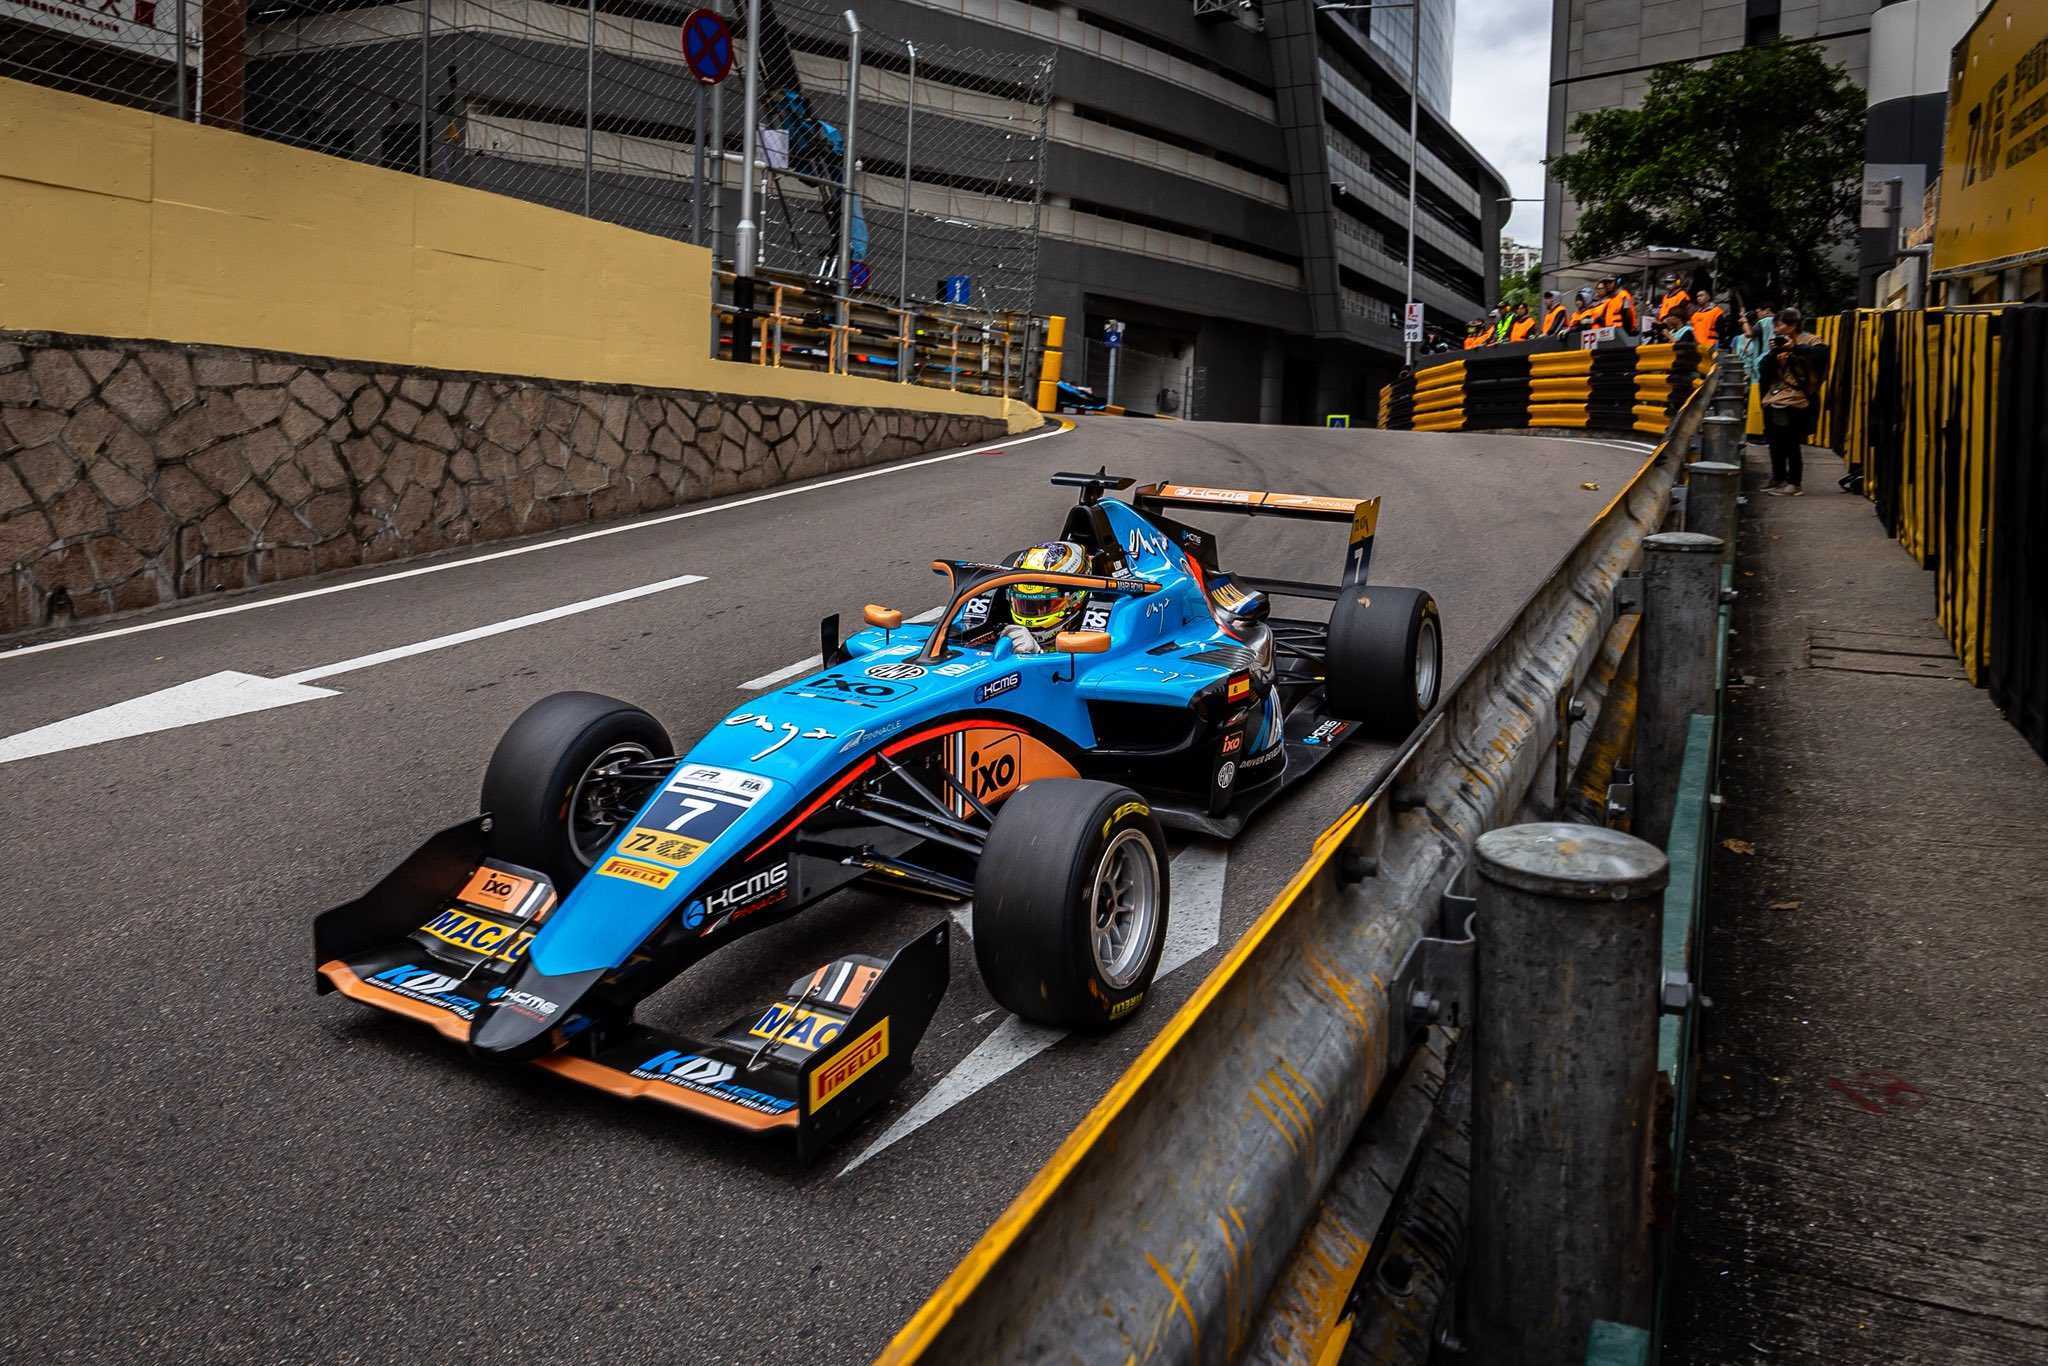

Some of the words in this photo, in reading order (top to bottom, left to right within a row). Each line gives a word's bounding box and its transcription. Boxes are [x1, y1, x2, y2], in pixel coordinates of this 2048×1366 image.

[965, 597, 990, 614] RS
[1081, 610, 1110, 628] RS
[984, 674, 1018, 696] KCMG
[1222, 735, 1240, 753] ixo
[740, 780, 761, 791] FIA
[970, 751, 1015, 800] ixo
[665, 798, 717, 831] 7
[624, 833, 658, 851] 72
[605, 860, 669, 883] PIRELLI
[481, 873, 512, 896] ixo
[706, 862, 788, 914] KCMG
[500, 988, 560, 1015] KCMG
[817, 1029, 882, 1101] PIRELLI
